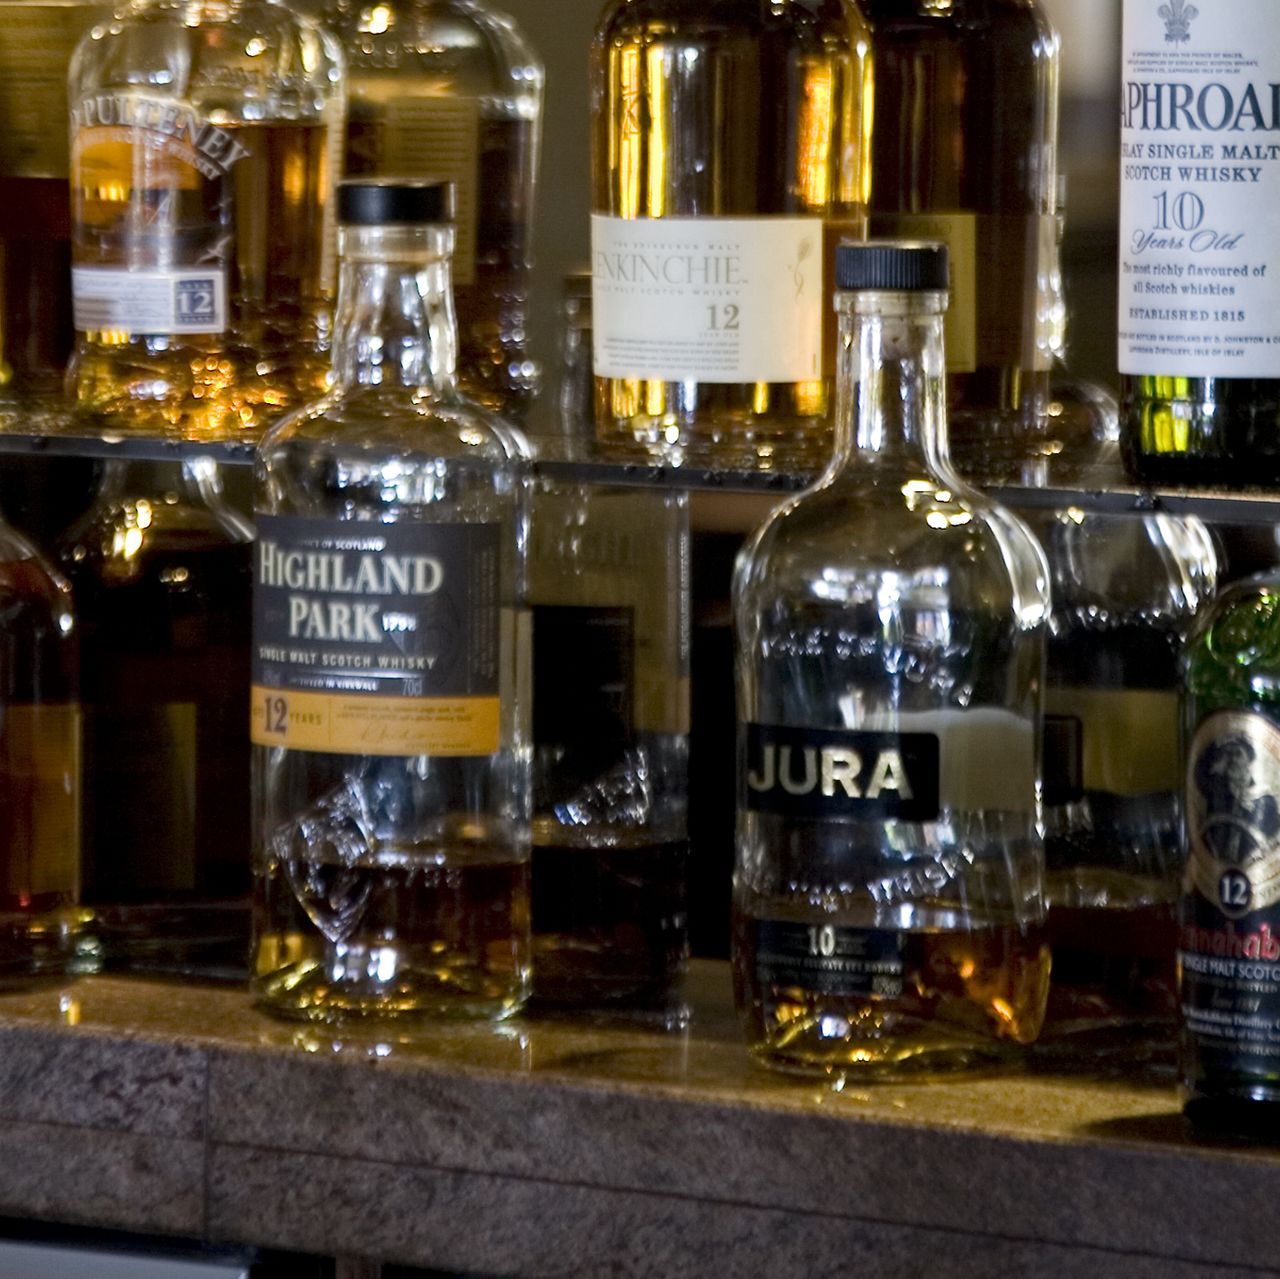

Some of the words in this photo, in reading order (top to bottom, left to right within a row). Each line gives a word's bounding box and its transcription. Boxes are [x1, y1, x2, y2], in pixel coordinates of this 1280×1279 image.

[1148, 144, 1214, 159] SINGLE
[1178, 166, 1264, 183] WHISKY
[1152, 190, 1205, 232] 10
[1130, 228, 1185, 255] Years
[1189, 230, 1246, 254] Old
[1153, 264, 1185, 278] richly
[1187, 264, 1249, 277] flavoured
[1252, 264, 1268, 277] of
[1145, 282, 1178, 295] Scotch
[1180, 283, 1236, 296] whiskies
[176, 291, 212, 315] 12
[1128, 307, 1210, 322] ESTABLISHED
[1214, 310, 1247, 323] 1815
[707, 304, 740, 332] 12
[289, 648, 317, 665] MALT
[322, 652, 371, 668] SCOTCH
[378, 655, 437, 670] WHISKY
[263, 696, 289, 736] 12
[748, 745, 914, 800] JURA
[1221, 876, 1248, 905] 12
[807, 924, 836, 957] 10
[1210, 959, 1235, 976] MALT
